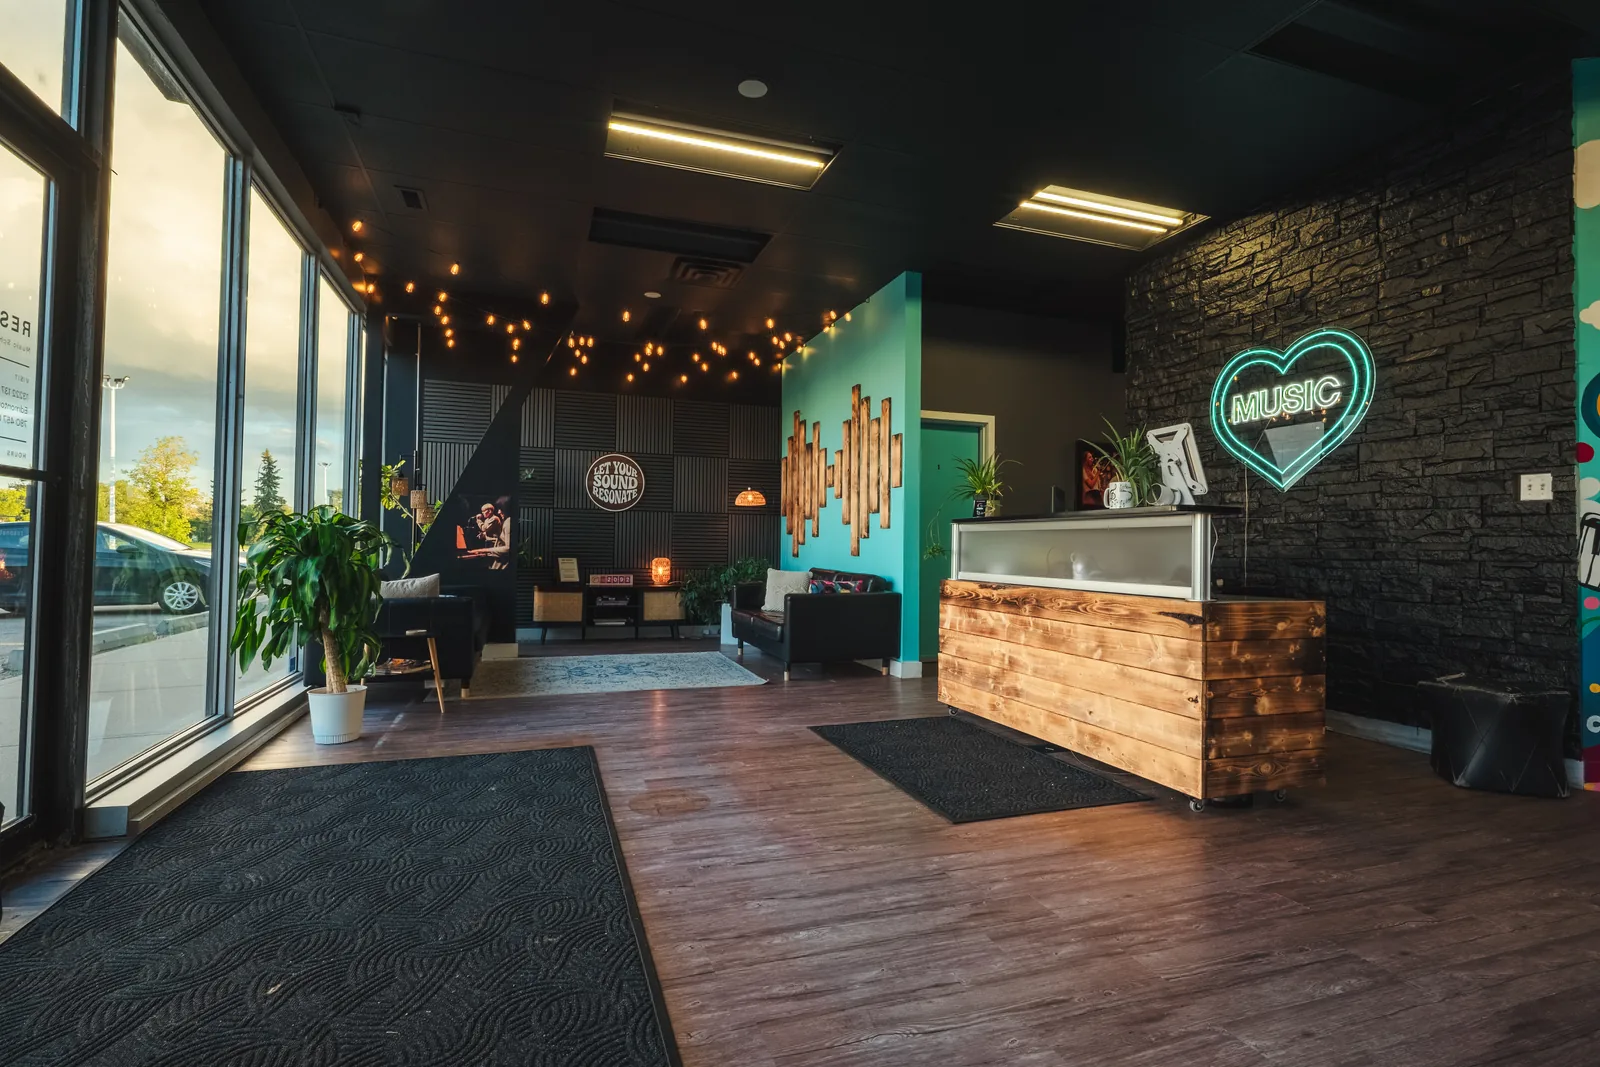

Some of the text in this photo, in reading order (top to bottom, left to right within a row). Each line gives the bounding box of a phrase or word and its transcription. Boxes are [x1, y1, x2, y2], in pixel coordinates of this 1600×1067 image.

[1231, 376, 1341, 425] MUSIC
[594, 461, 638, 477] LET YOUR
[593, 474, 638, 490] SOUND
[593, 486, 638, 504] RESONATE
